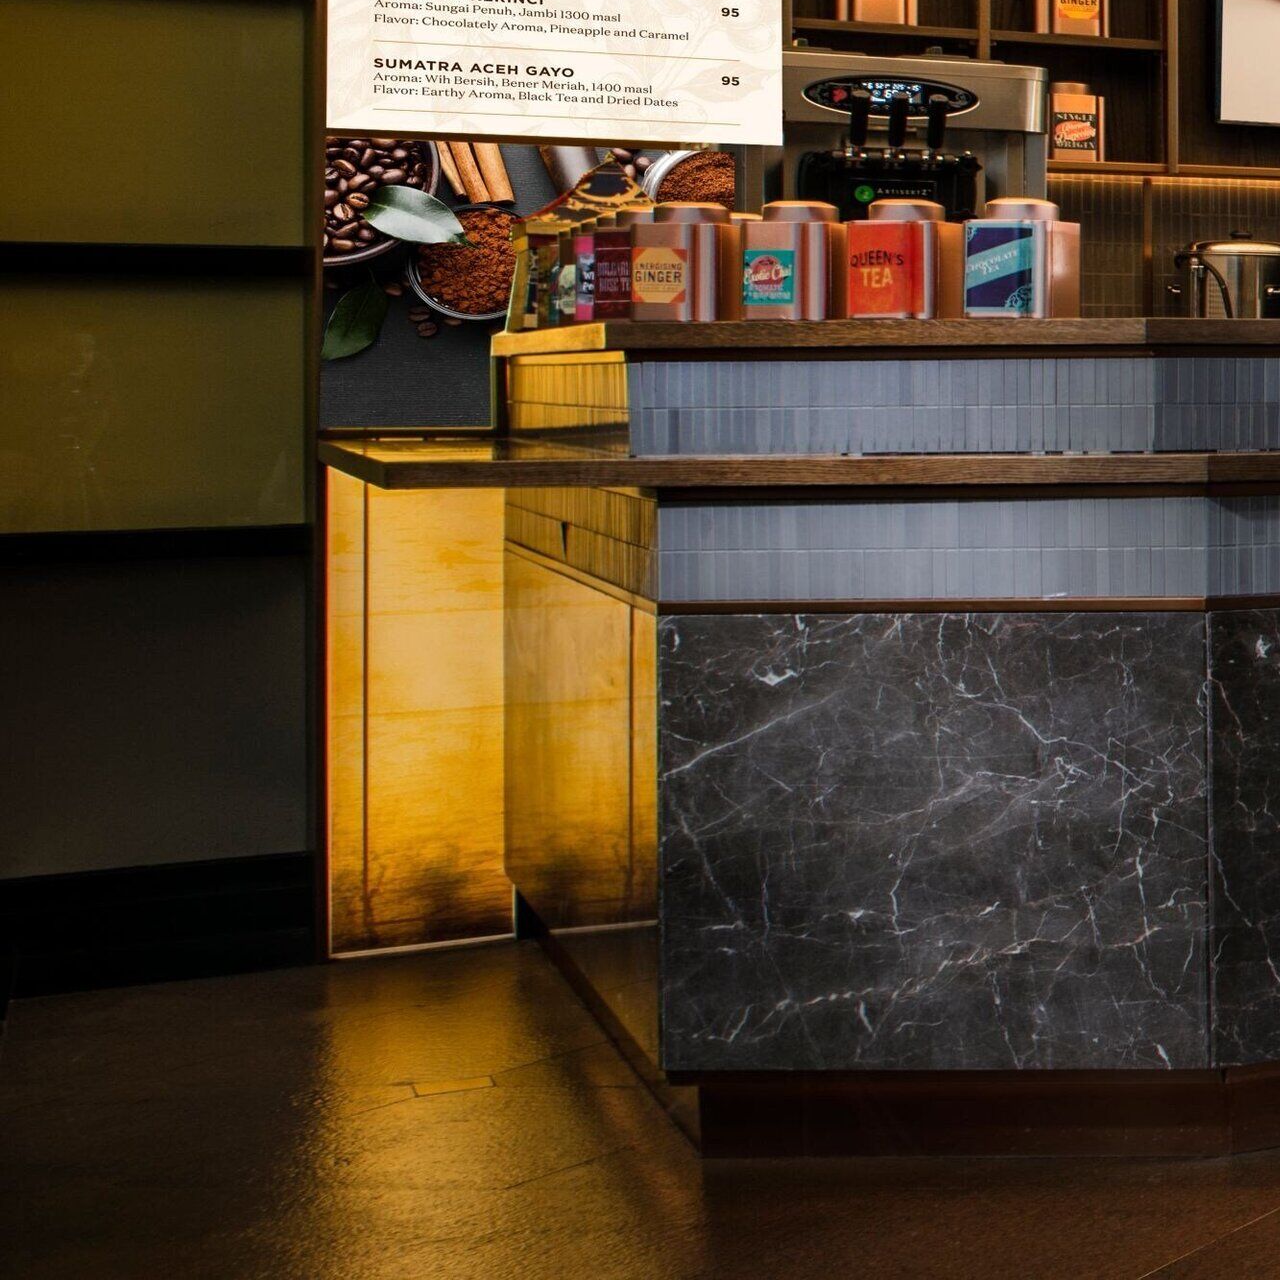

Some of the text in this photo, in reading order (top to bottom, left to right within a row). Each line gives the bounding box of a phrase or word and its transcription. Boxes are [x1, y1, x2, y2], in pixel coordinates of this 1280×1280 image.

[374, 0, 621, 23] Aroma: Sungai Penuh, Jambi 1300 masl
[721, 7, 740, 18] 95
[374, 14, 689, 41] Flavor: Chocolately Aroma, Pineapple and Caramel
[374, 58, 575, 78] SUMATRA ACEH GAYO
[373, 72, 653, 94] Aroma: Wih Bersih, Bener Meriah, 1400 masl
[721, 76, 740, 87] 95
[373, 84, 679, 108] Flavor: Earthy Aroma, Black Tea and Dried Dates
[1056, 113, 1096, 122] SINGLE
[850, 249, 905, 268] QUEEN'S
[634, 270, 683, 283] GINGER
[859, 267, 894, 289] TEA
